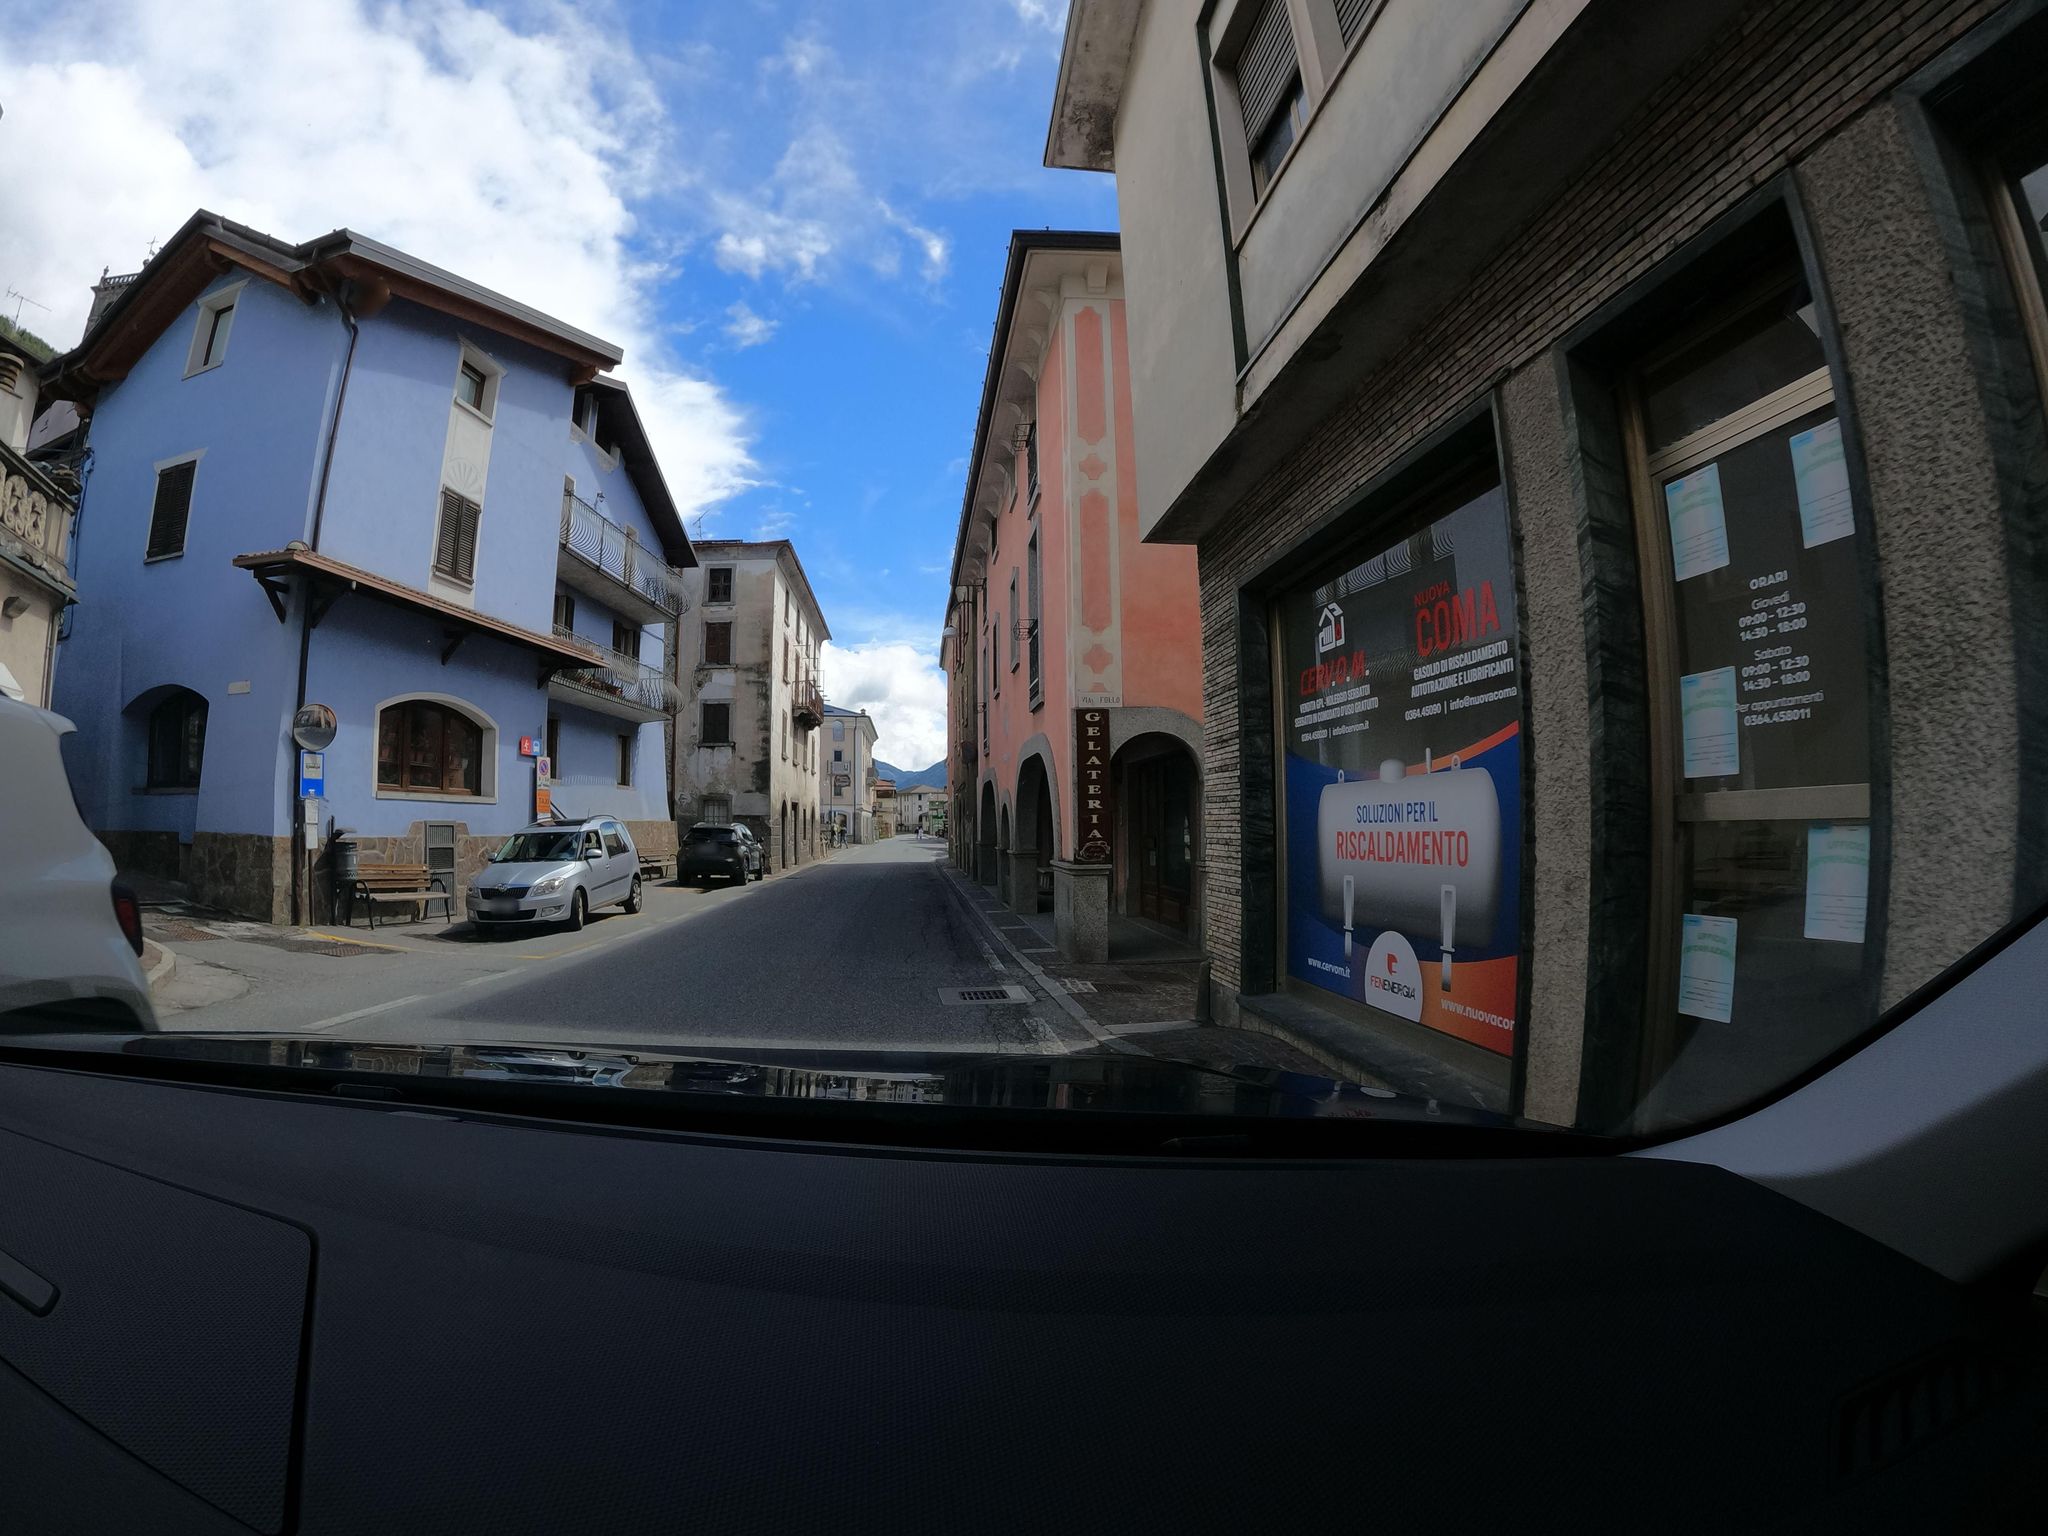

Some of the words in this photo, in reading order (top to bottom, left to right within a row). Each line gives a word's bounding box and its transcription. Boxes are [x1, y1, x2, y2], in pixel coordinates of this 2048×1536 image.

[1749, 570, 1788, 590] ORARI
[1413, 580, 1451, 607] NUOVA
[1416, 580, 1501, 657] COMA
[1739, 611, 1768, 628] 09:00
[1776, 602, 1806, 618] 12:30
[1740, 626, 1768, 642] 14:30
[1413, 661, 1440, 681] GASOLIO
[1440, 658, 1448, 673] DI
[1448, 639, 1508, 671] RISCALDAMENTO
[1754, 645, 1792, 661] Sabato
[1411, 673, 1458, 699] AUTOTRAZIONE
[1458, 672, 1463, 686] E
[1464, 657, 1514, 684] LUBRIFICANTI
[1742, 662, 1771, 678] 09:00
[1779, 655, 1810, 670] 12:30
[1742, 677, 1771, 692] 14:30
[1084, 712, 1103, 839] GELATERIA
[1356, 803, 1404, 824] SOLUZIONI
[1406, 802, 1427, 823] PER
[1428, 801, 1438, 823] IL
[1336, 830, 1469, 868] RISCALDAMENTO
[1307, 957, 1351, 979] www.cervom.it
[1370, 975, 1416, 1001] FENENERGIA
